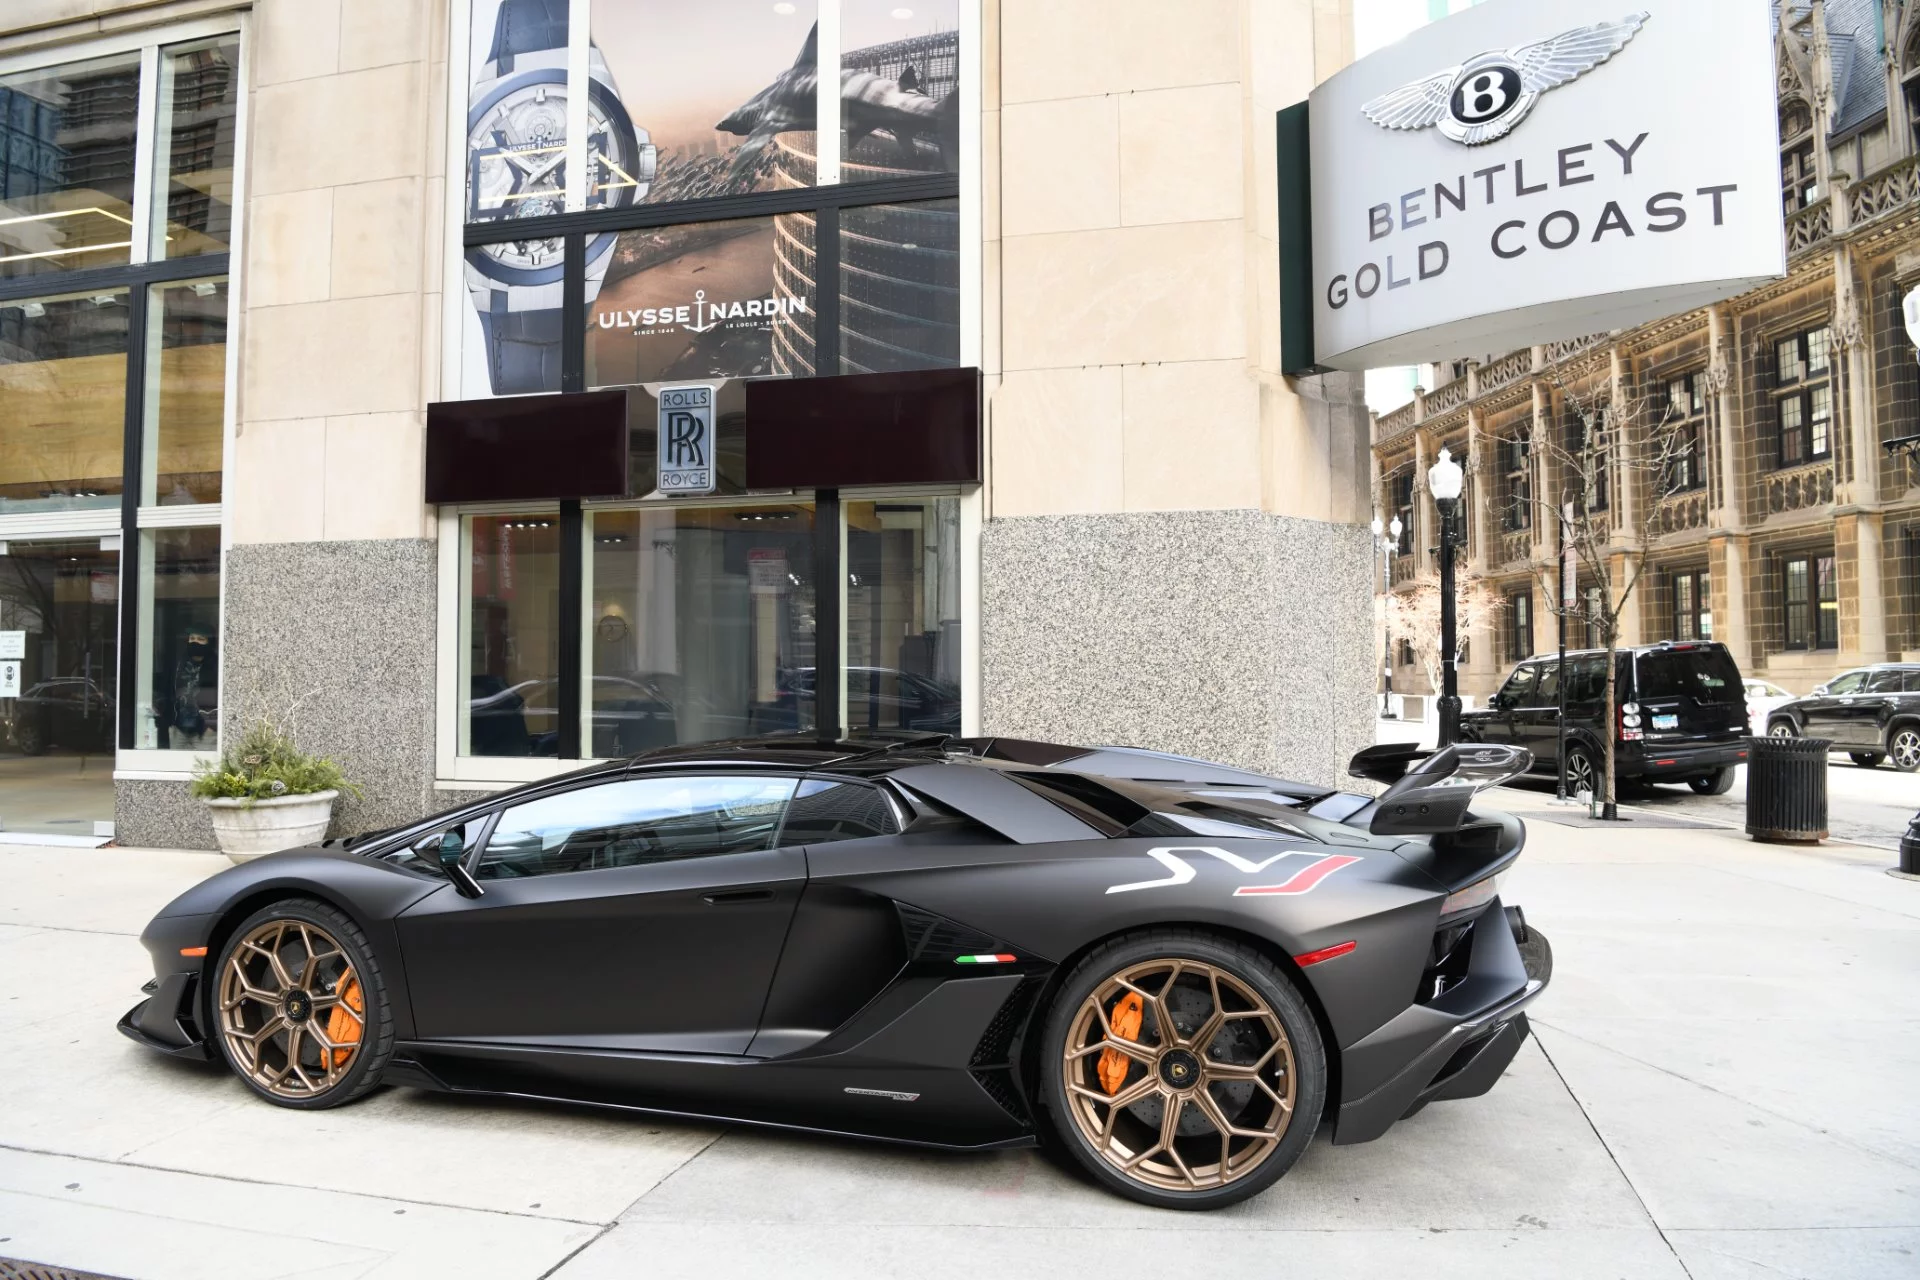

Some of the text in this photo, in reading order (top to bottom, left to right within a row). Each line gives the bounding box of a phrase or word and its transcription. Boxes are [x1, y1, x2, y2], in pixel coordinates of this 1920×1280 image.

[1461, 70, 1507, 118] B
[543, 140, 567, 149] NARDI
[1368, 131, 1650, 243] BENTLEY
[1326, 183, 1738, 311] GOLD COAST
[600, 297, 806, 329] ULYSSE NARDIN
[663, 392, 707, 406] ROLLS
[667, 411, 705, 467] RR
[662, 472, 706, 487] ROYCE
